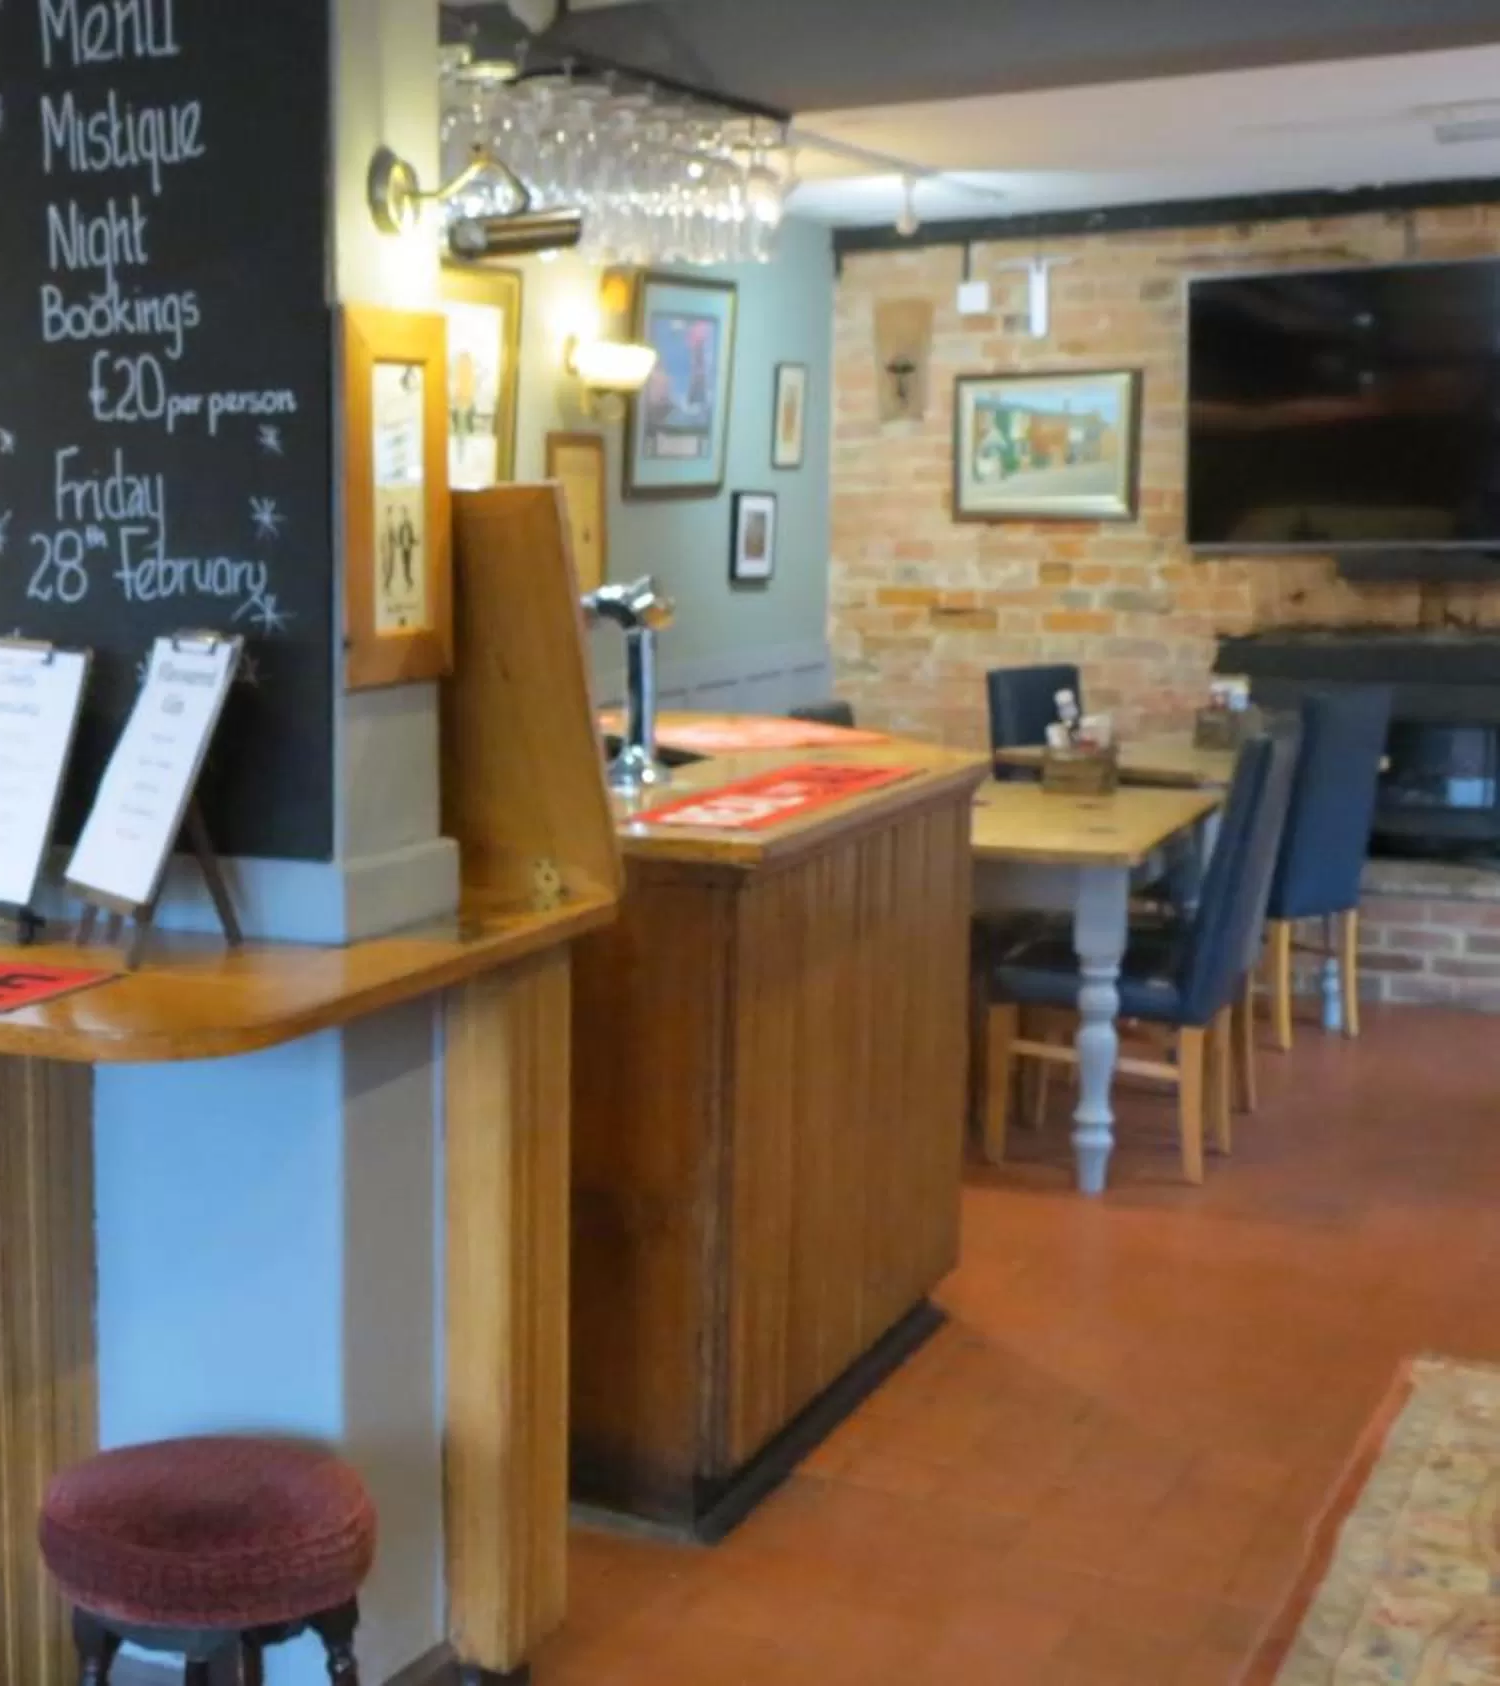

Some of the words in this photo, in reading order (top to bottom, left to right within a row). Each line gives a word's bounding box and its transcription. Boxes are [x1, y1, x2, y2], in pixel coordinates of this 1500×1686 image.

[40, 0, 180, 68] Menu
[41, 89, 205, 196] Mistique
[48, 196, 148, 298] Night
[41, 284, 201, 360] Bookings
[89, 351, 164, 421] £20
[166, 394, 203, 433] per
[207, 387, 297, 436] person
[55, 446, 165, 550] Friday
[112, 525, 269, 622] February
